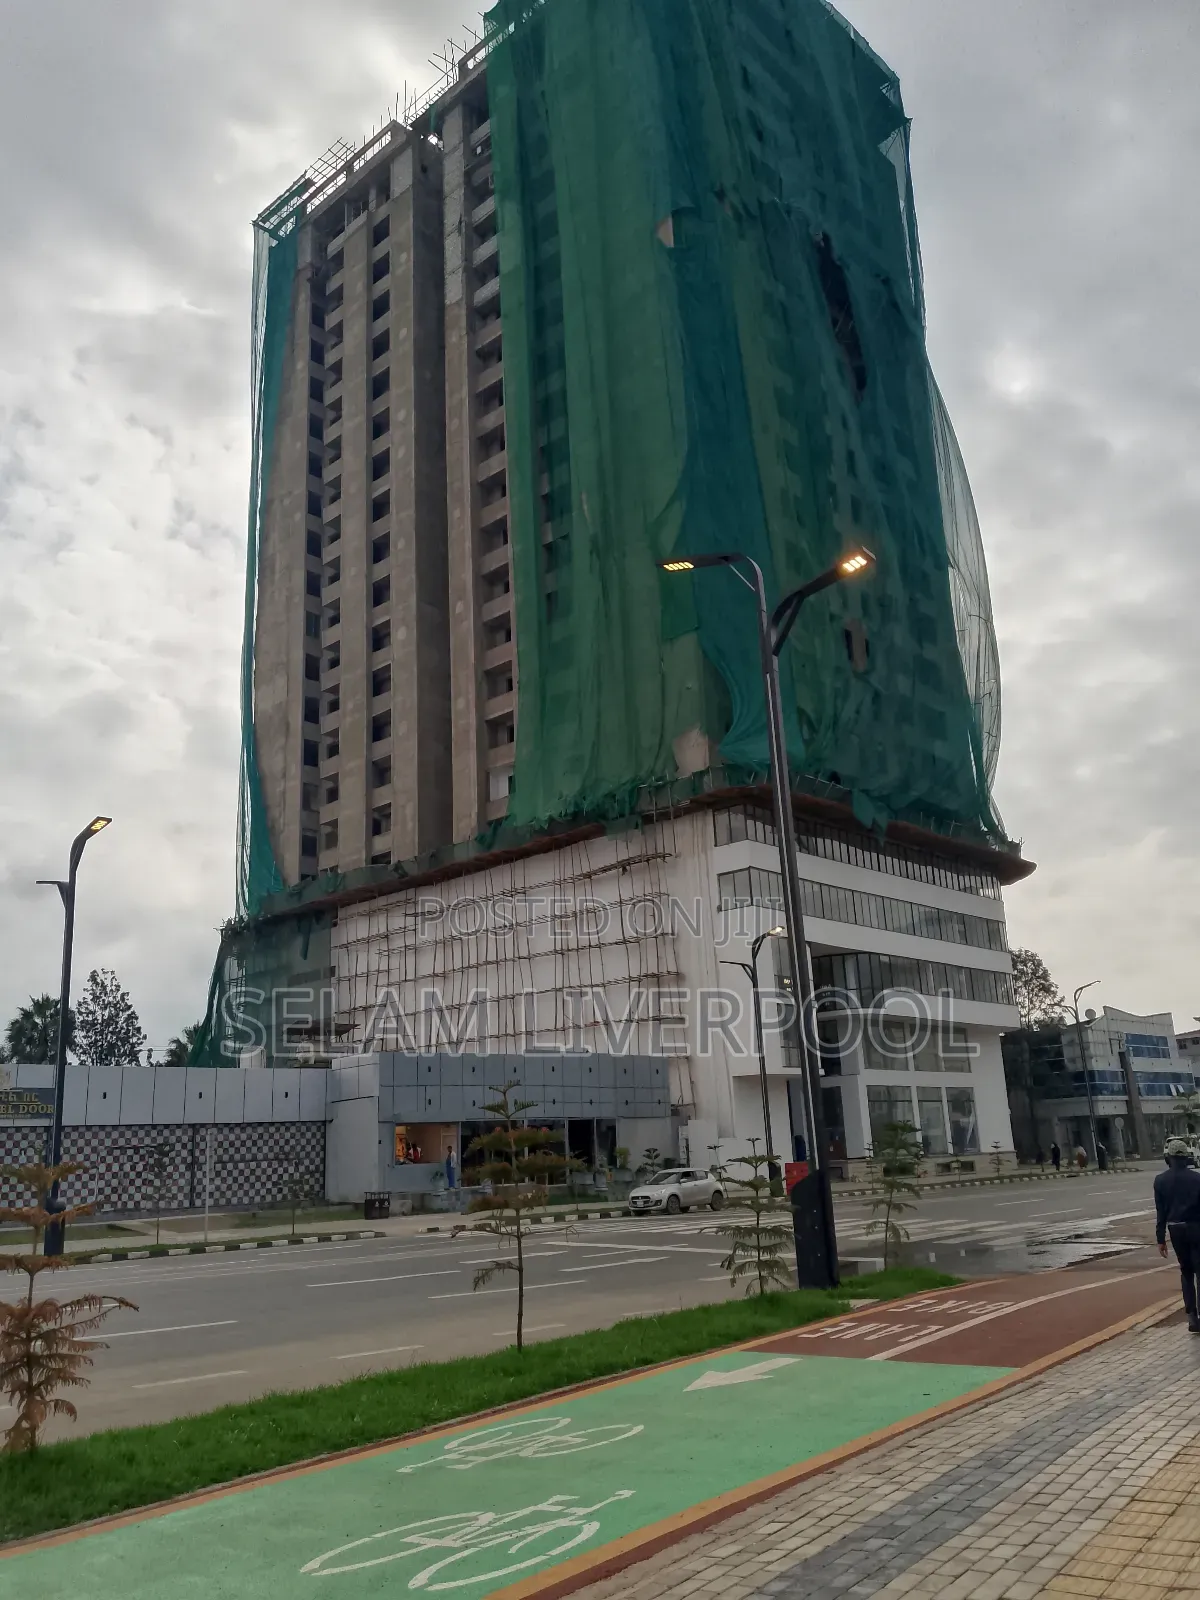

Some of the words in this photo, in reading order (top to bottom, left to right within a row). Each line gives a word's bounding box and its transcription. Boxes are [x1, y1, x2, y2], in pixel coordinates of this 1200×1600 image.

[19, 1104, 54, 1114] DOOR
[886, 1299, 1015, 1314] BIKE
[797, 1322, 945, 1342] LANE
